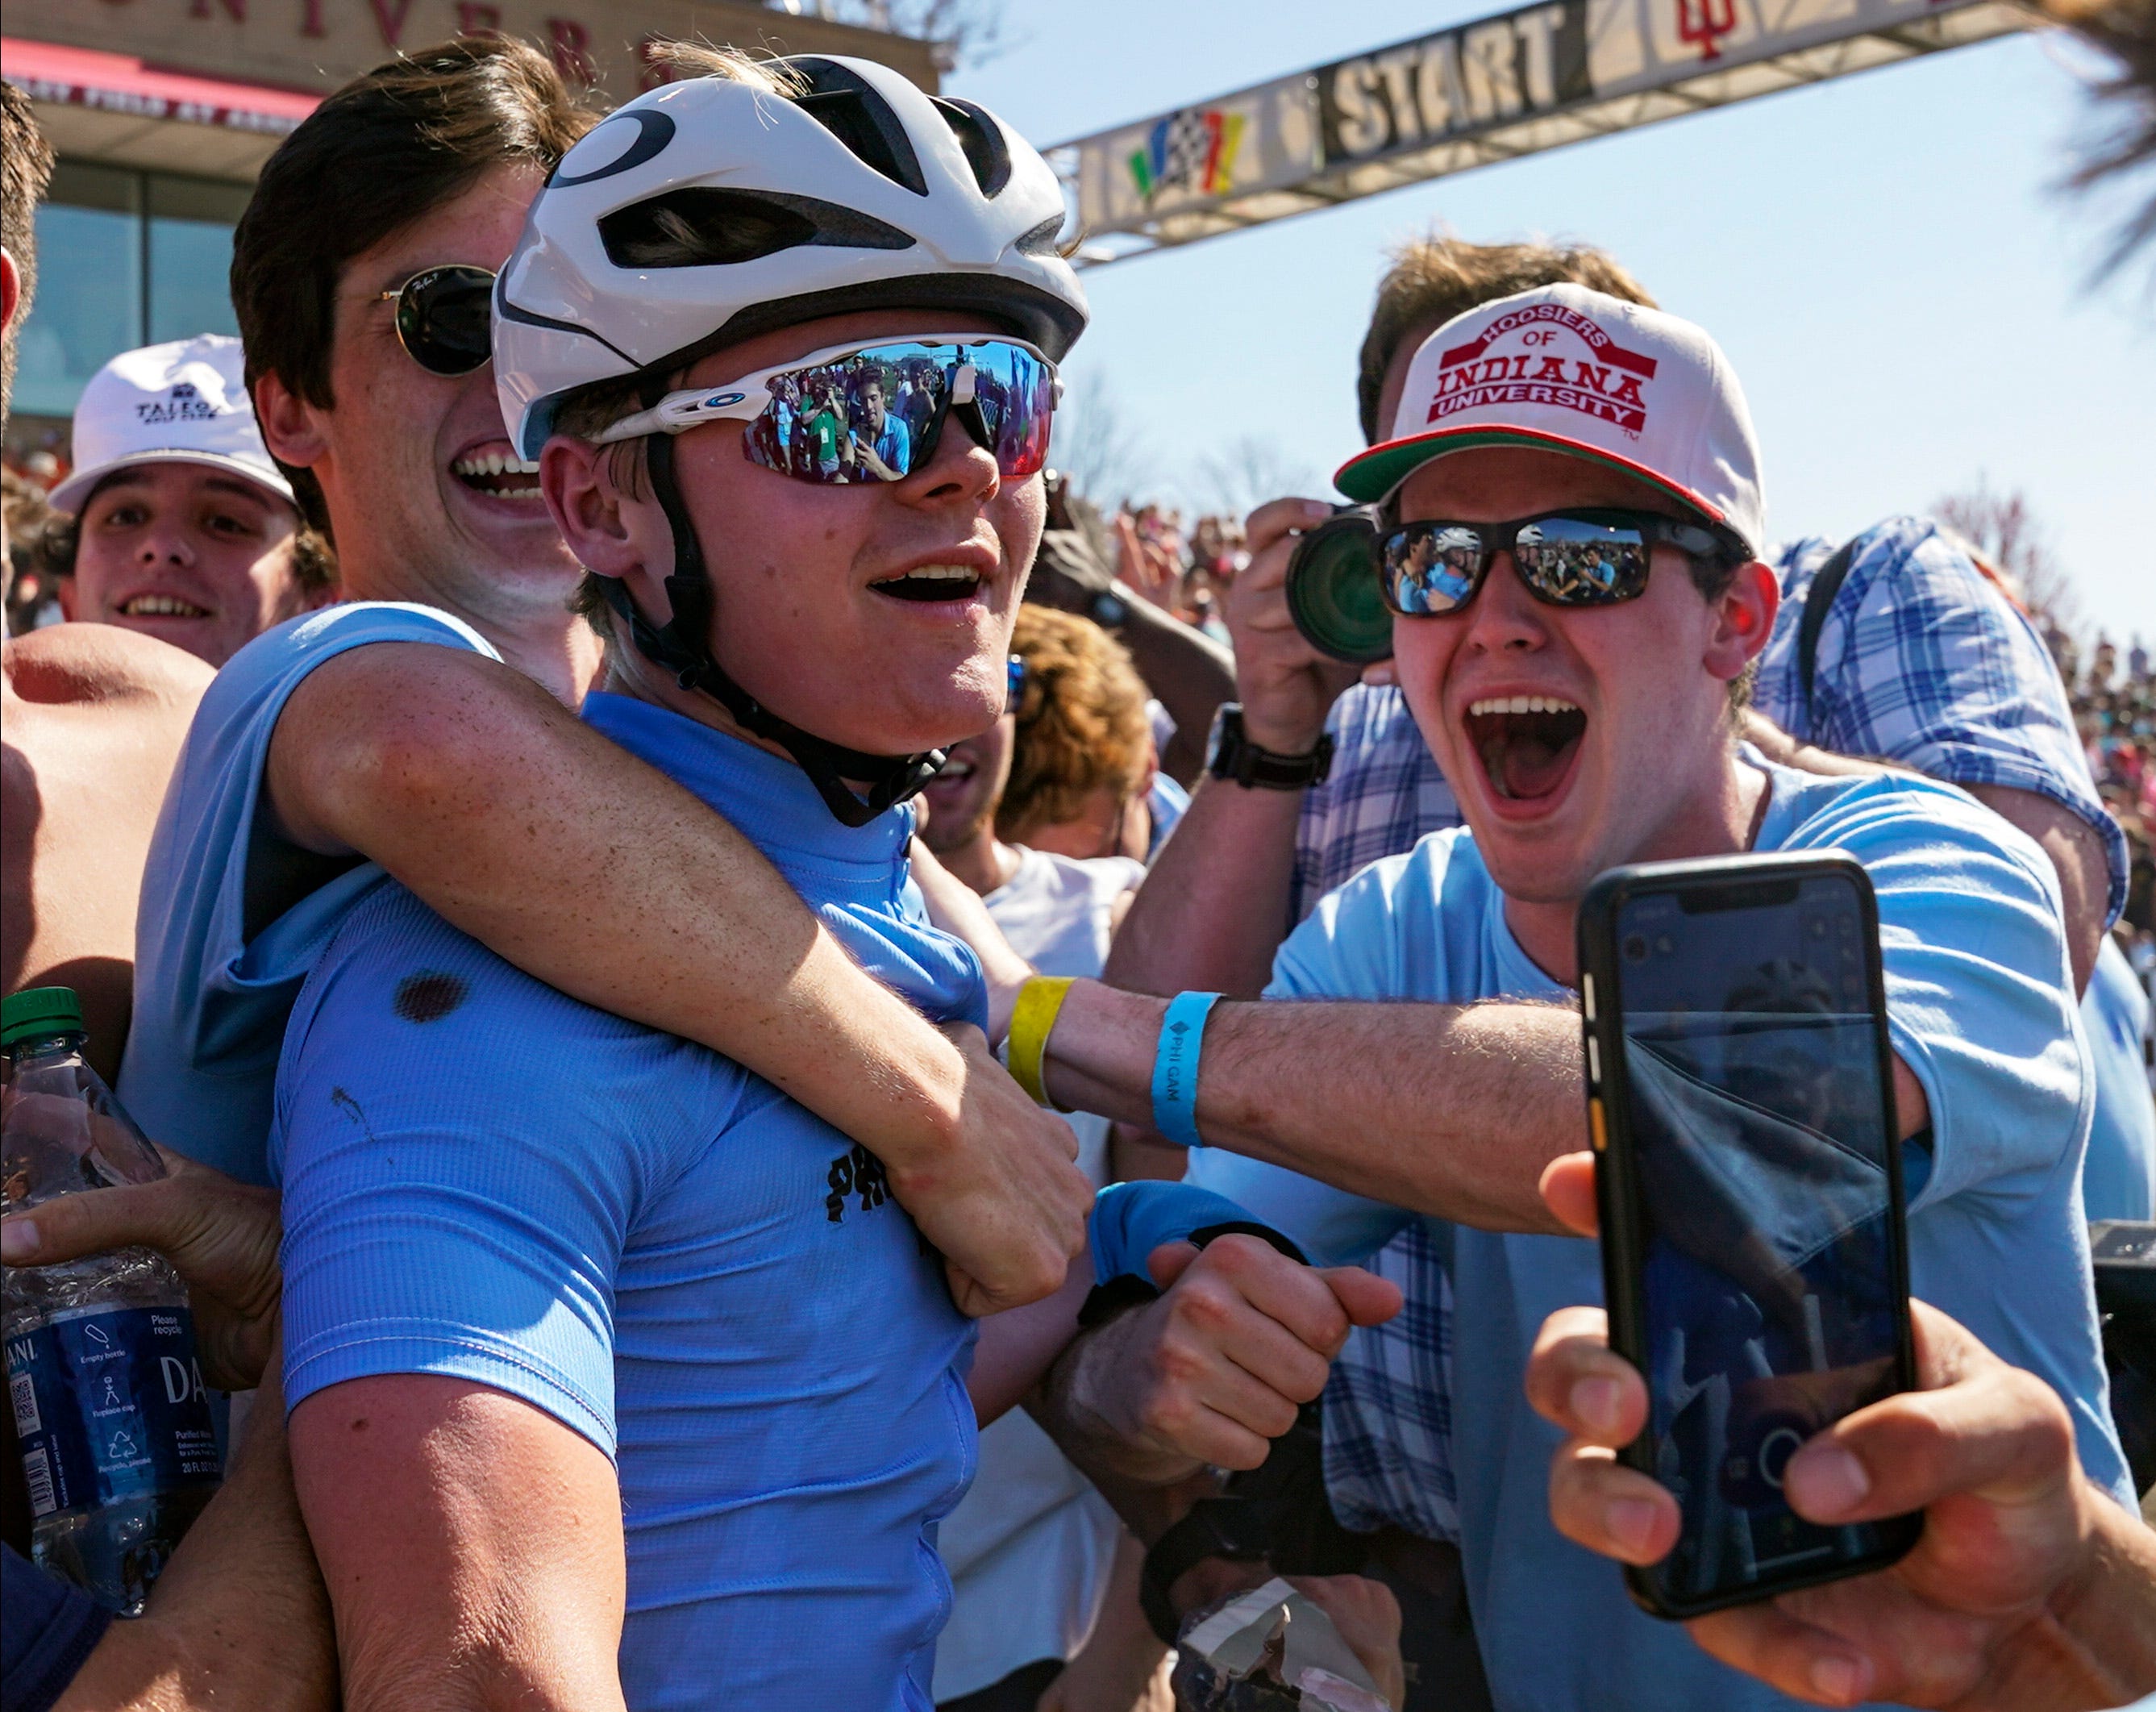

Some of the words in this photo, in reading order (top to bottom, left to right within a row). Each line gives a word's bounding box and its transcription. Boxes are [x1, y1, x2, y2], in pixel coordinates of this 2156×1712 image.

[1333, 4, 1565, 158] START
[1482, 304, 1609, 348] HOOSIERS
[1521, 331, 1558, 347] OF
[1433, 355, 1646, 410] INDIANA
[1437, 385, 1634, 424] UNIVERSITY
[1169, 1036, 1184, 1061] PHI
[1167, 1066, 1180, 1102] GAM
[151, 1314, 178, 1325] Please
[153, 1325, 182, 1336] recycle
[81, 1352, 104, 1364] Empty
[105, 1349, 126, 1360] bottle
[93, 1406, 121, 1418] Replace
[122, 1404, 136, 1413] cap
